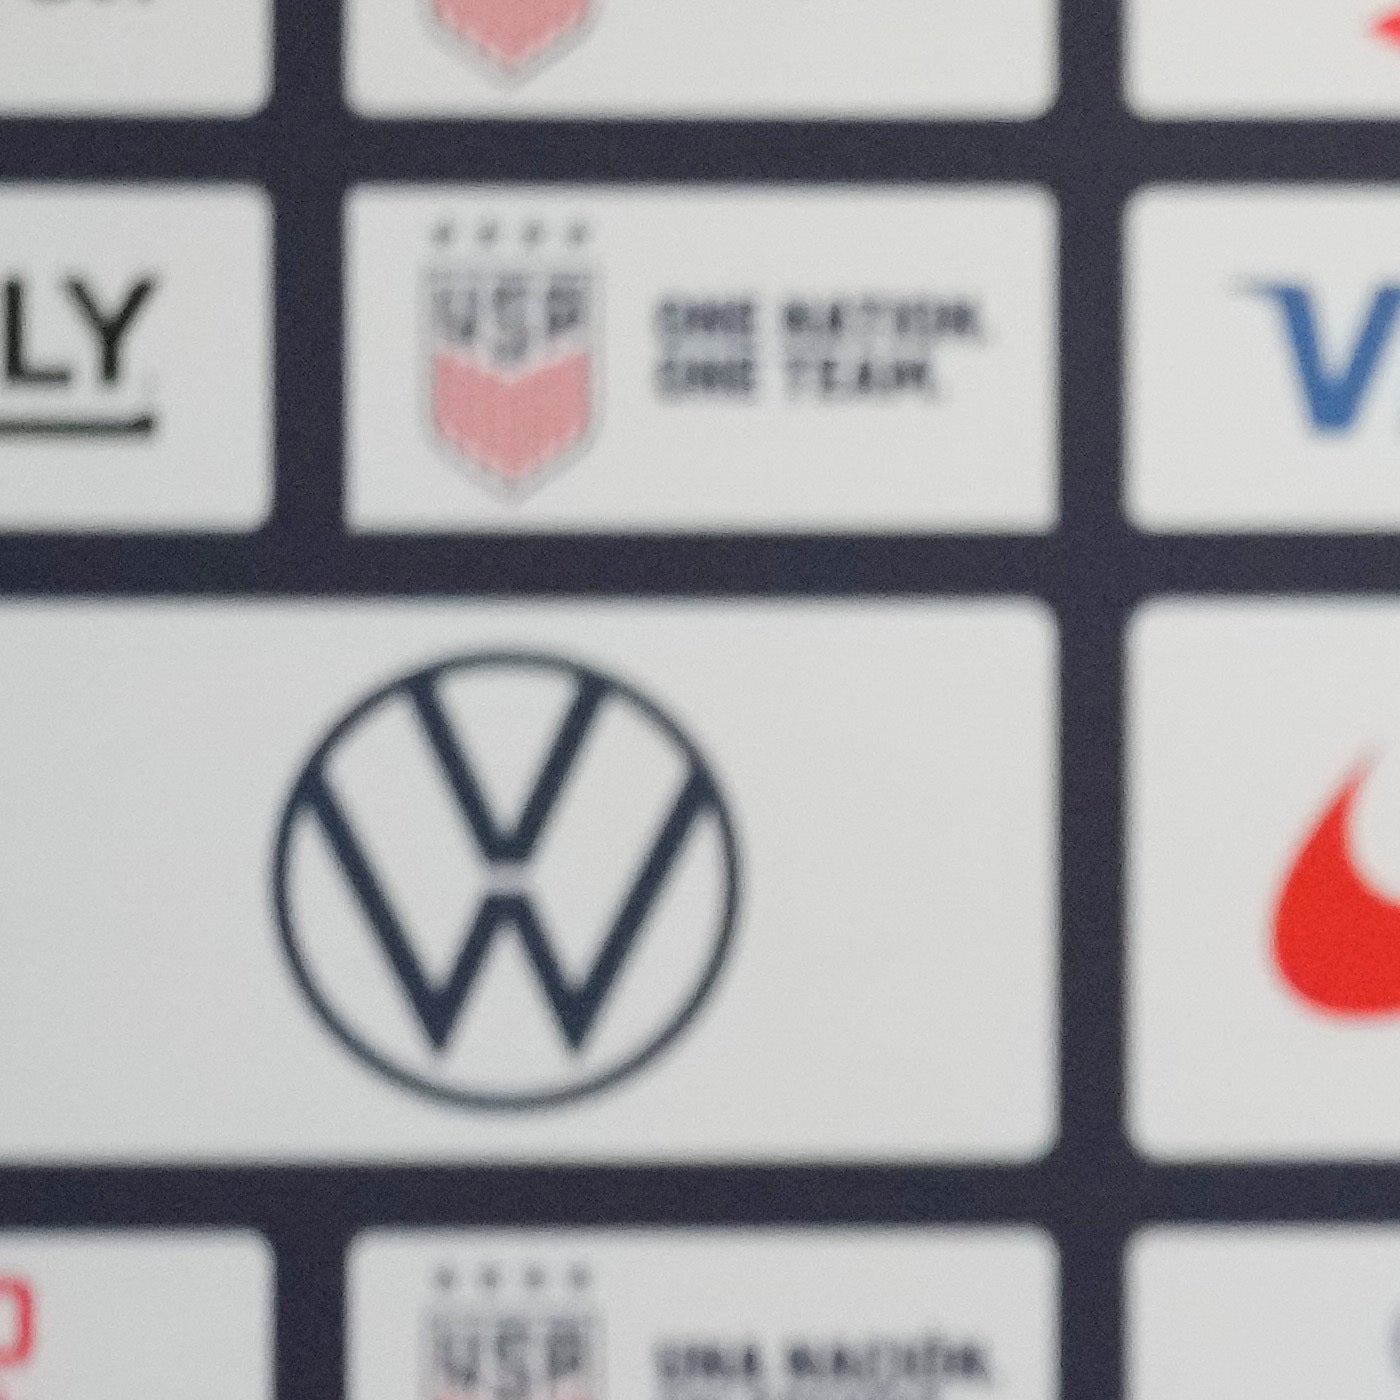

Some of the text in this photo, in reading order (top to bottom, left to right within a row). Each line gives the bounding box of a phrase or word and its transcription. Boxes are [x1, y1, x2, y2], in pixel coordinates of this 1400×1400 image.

[655, 298, 758, 336] ONE
[655, 355, 758, 397] ONE
[656, 1342, 765, 1384] UNA
